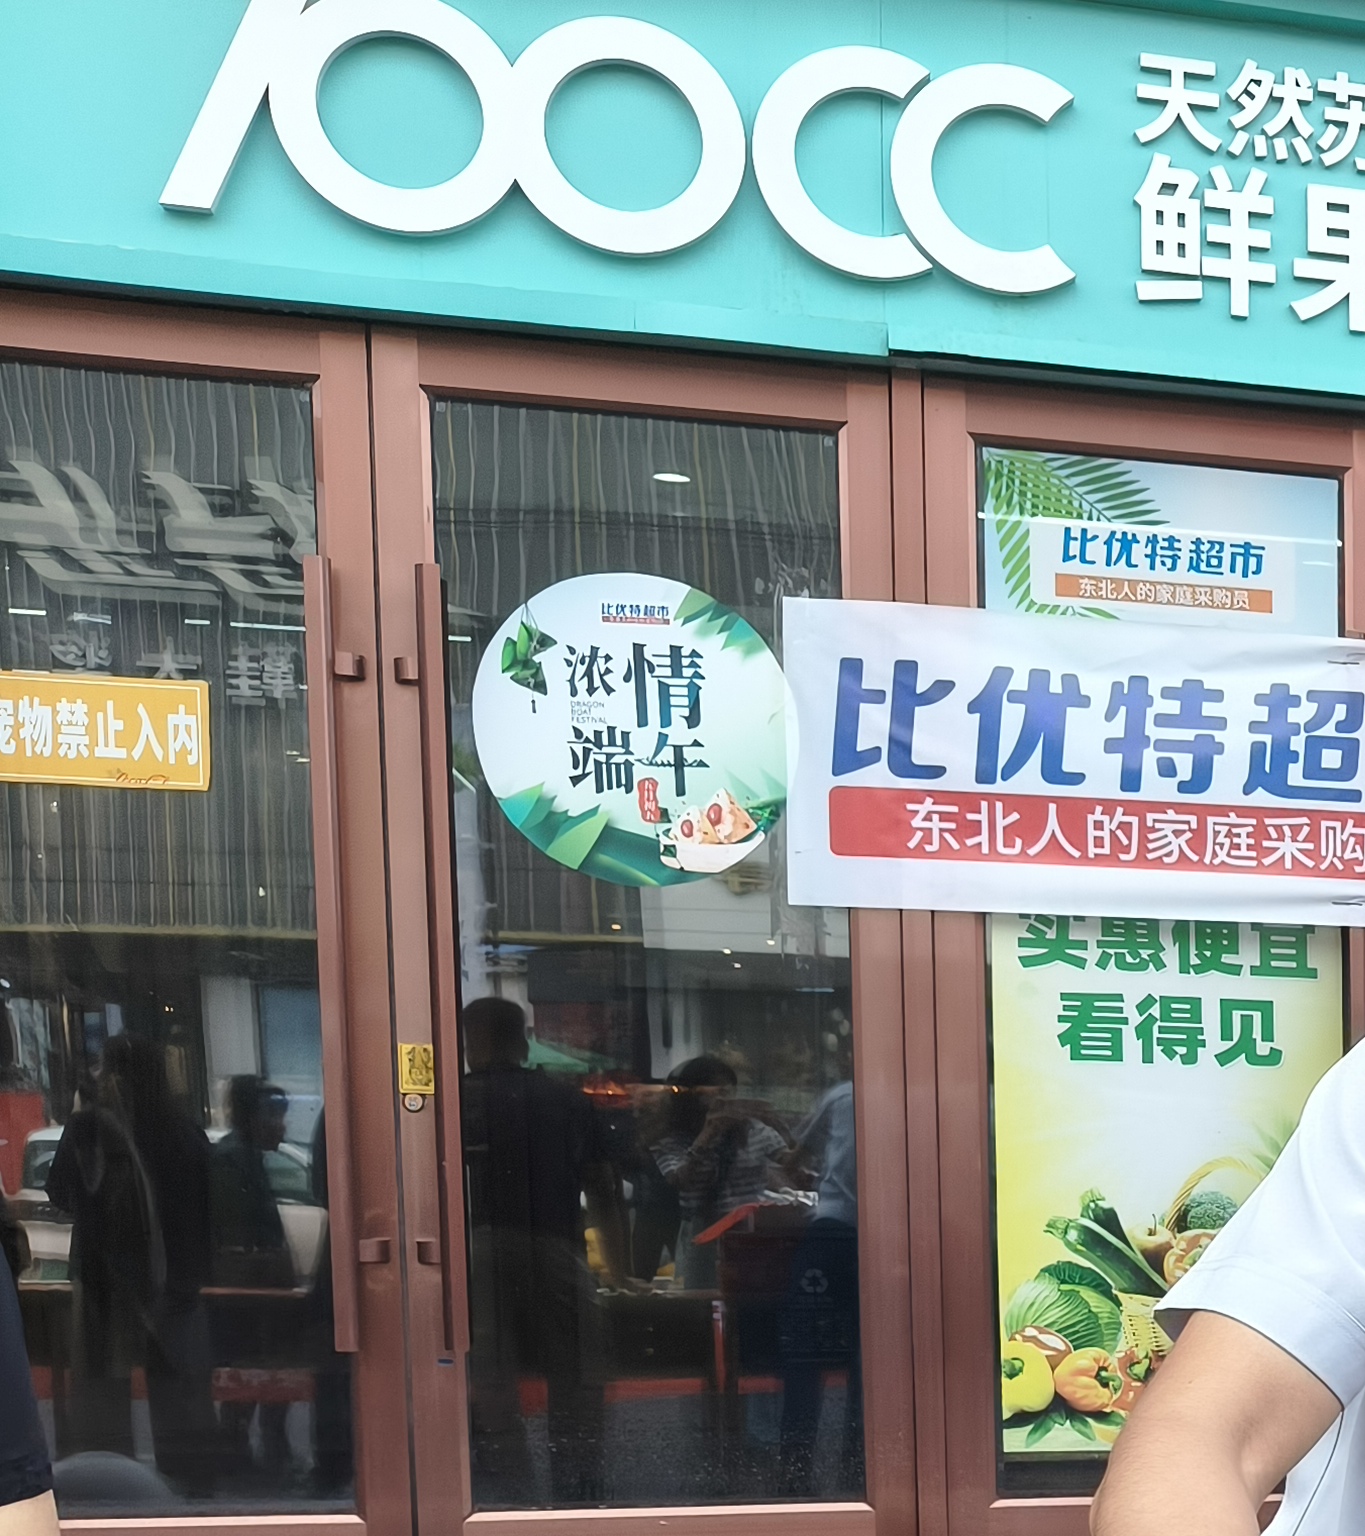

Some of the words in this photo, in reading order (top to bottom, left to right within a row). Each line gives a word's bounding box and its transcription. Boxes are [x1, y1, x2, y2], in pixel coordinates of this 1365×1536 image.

[1061, 526, 1267, 579] 比优特超市
[601, 602, 670, 618] 比优特超市
[1077, 575, 1251, 612] 东北人的家庭采购员
[563, 642, 706, 730] 浓情
[566, 725, 711, 798] 端午
[1057, 992, 1284, 1068] 看得见
